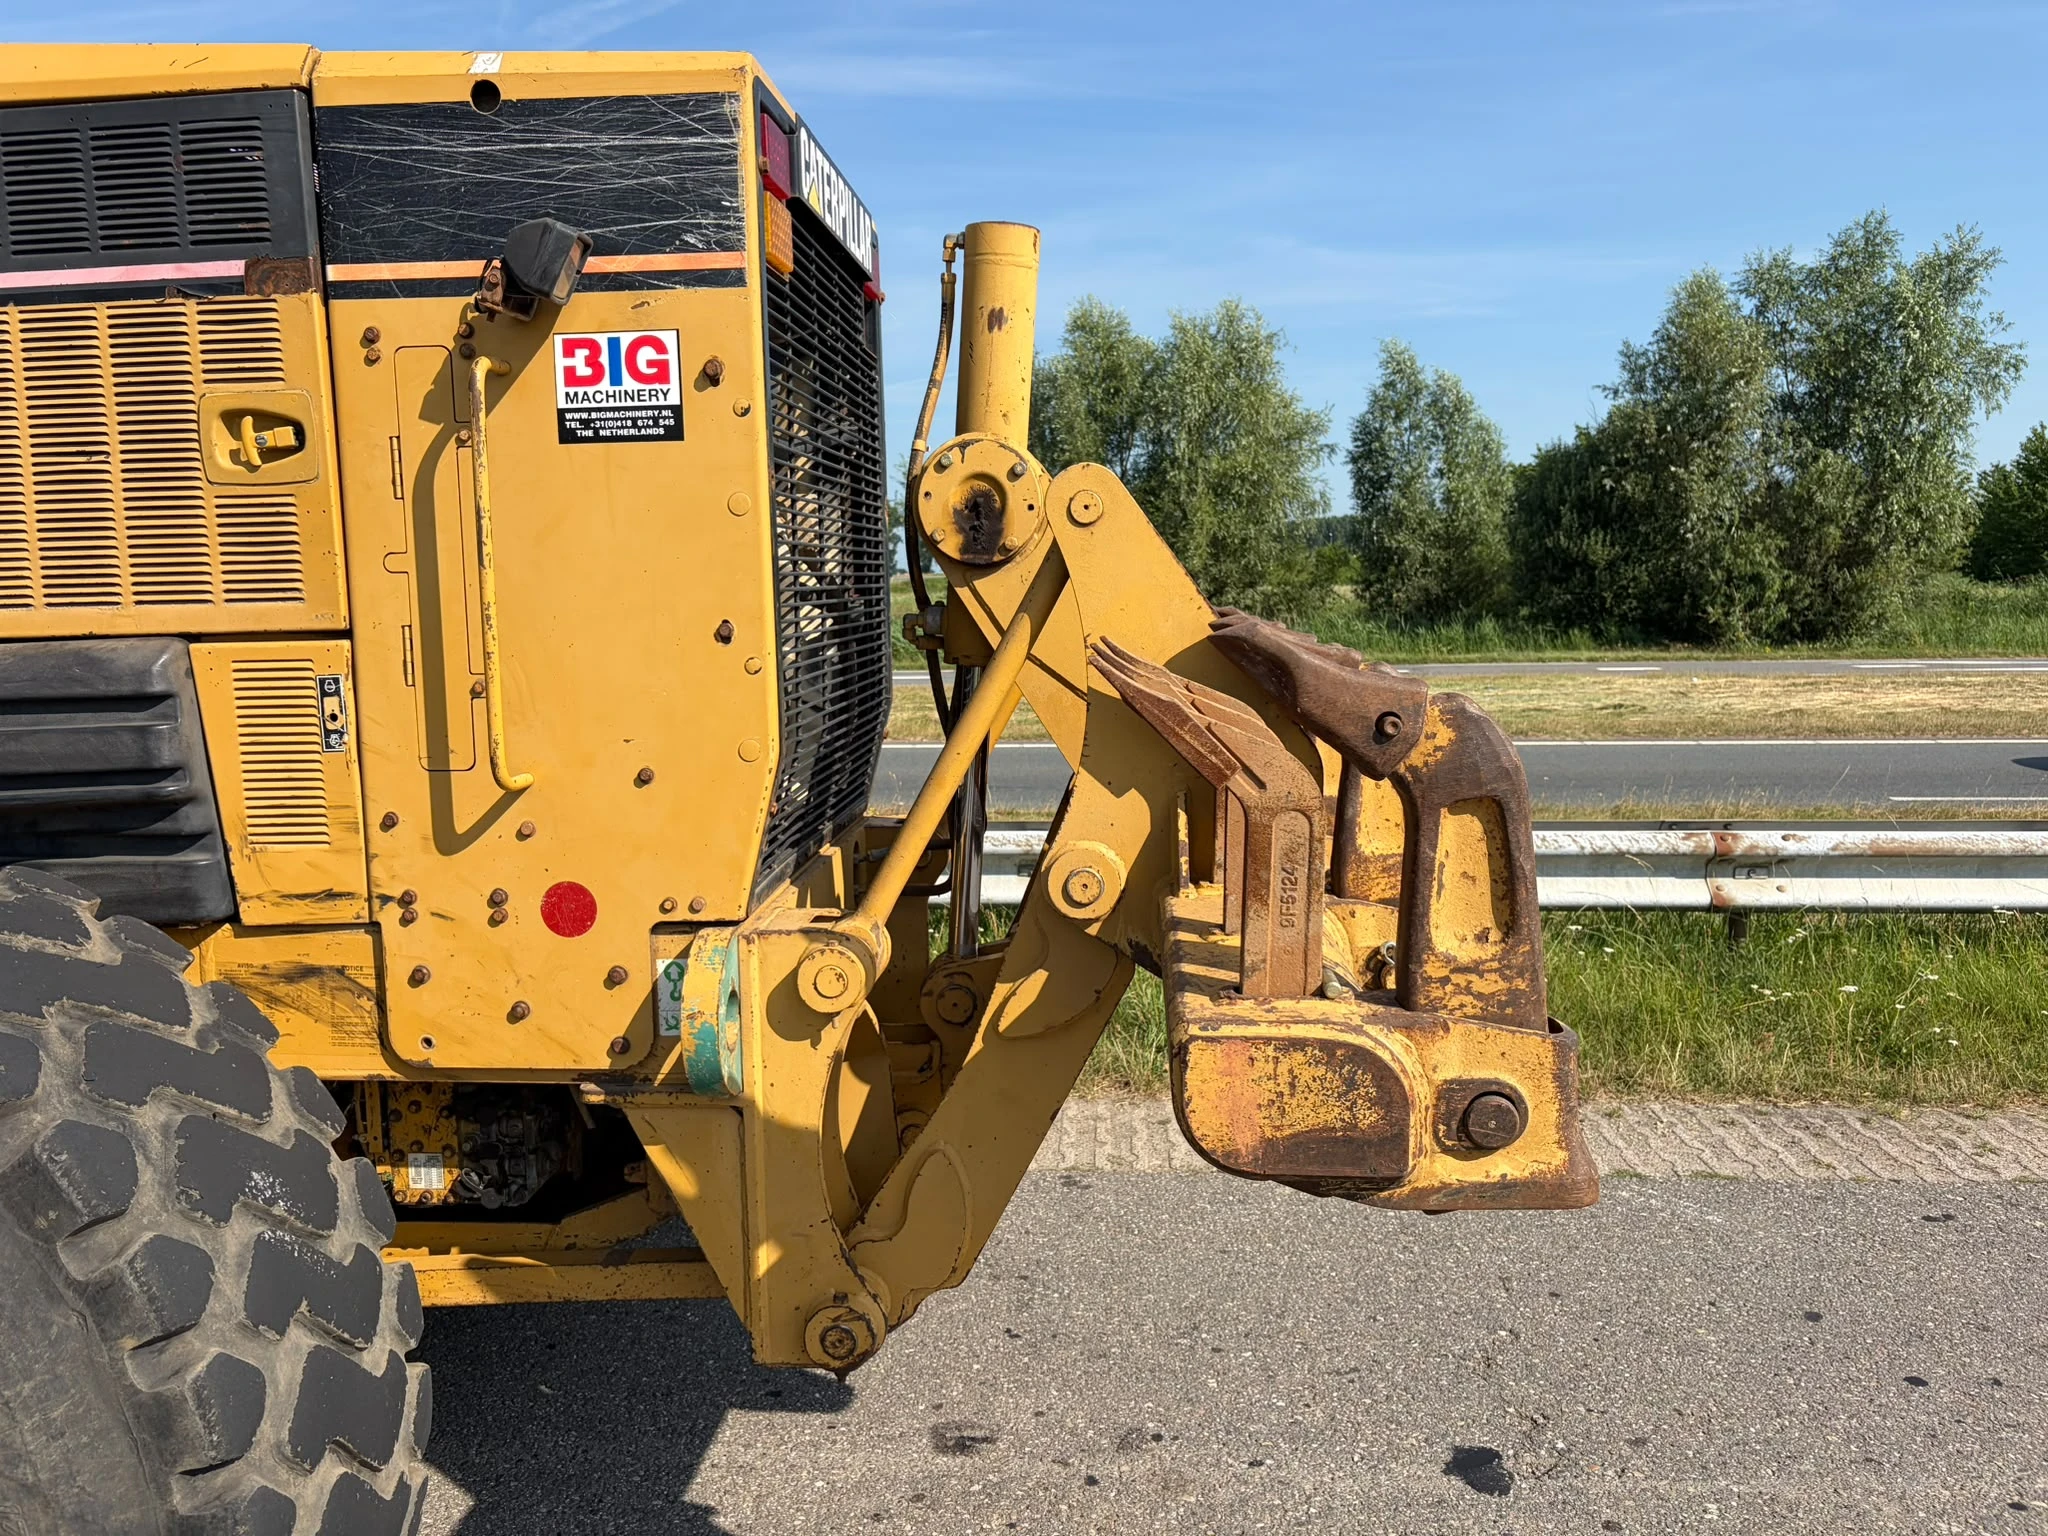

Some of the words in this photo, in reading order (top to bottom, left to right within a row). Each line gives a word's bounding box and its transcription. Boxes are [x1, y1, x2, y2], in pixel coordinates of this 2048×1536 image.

[800, 126, 872, 273] CATERPILLAR
[562, 335, 671, 388] BIG
[564, 388, 671, 405] MACHINERY
[564, 409, 674, 420] WWW.BIGMACHINERY.NL
[564, 421, 585, 429] TEL.
[589, 419, 633, 429] +31(0)418
[637, 419, 653, 427] 674
[658, 418, 675, 426] 545
[576, 429, 594, 437] THE
[599, 427, 665, 437] NETHERLANDS
